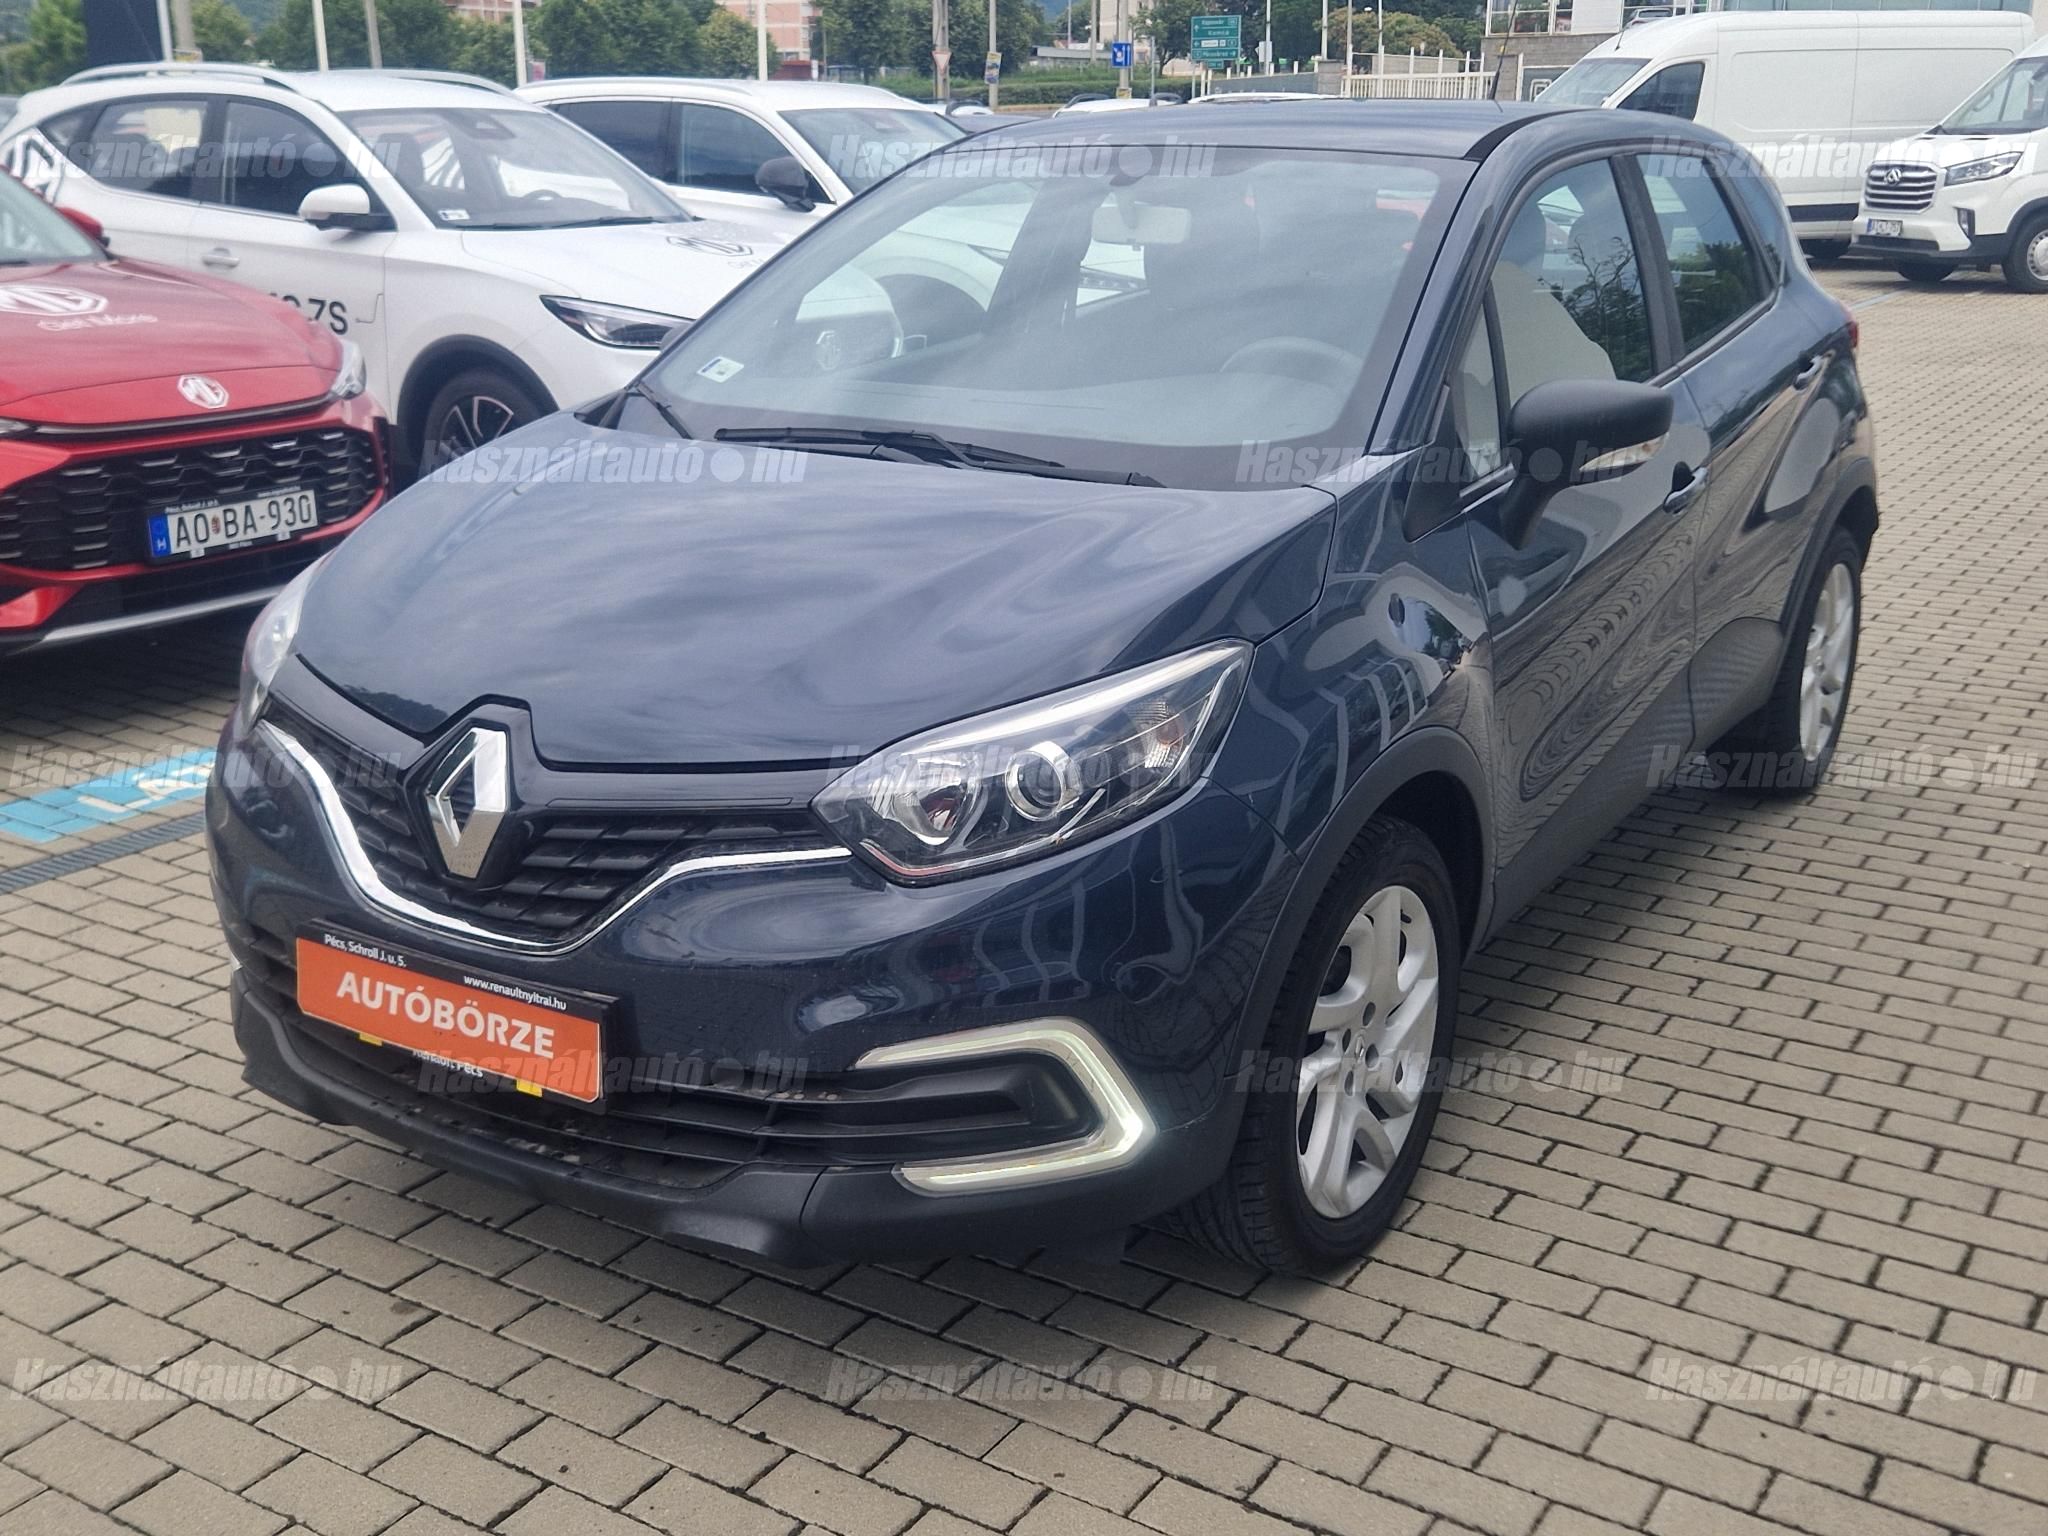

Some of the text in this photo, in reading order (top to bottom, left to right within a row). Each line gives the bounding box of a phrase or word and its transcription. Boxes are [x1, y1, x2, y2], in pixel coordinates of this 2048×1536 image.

[223, 494, 313, 540] BA-930
[347, 940, 379, 960] Schroll
[463, 975, 567, 1011] www.renaultnyitrai.hu
[336, 971, 555, 1060] AUTÓBÖRZE
